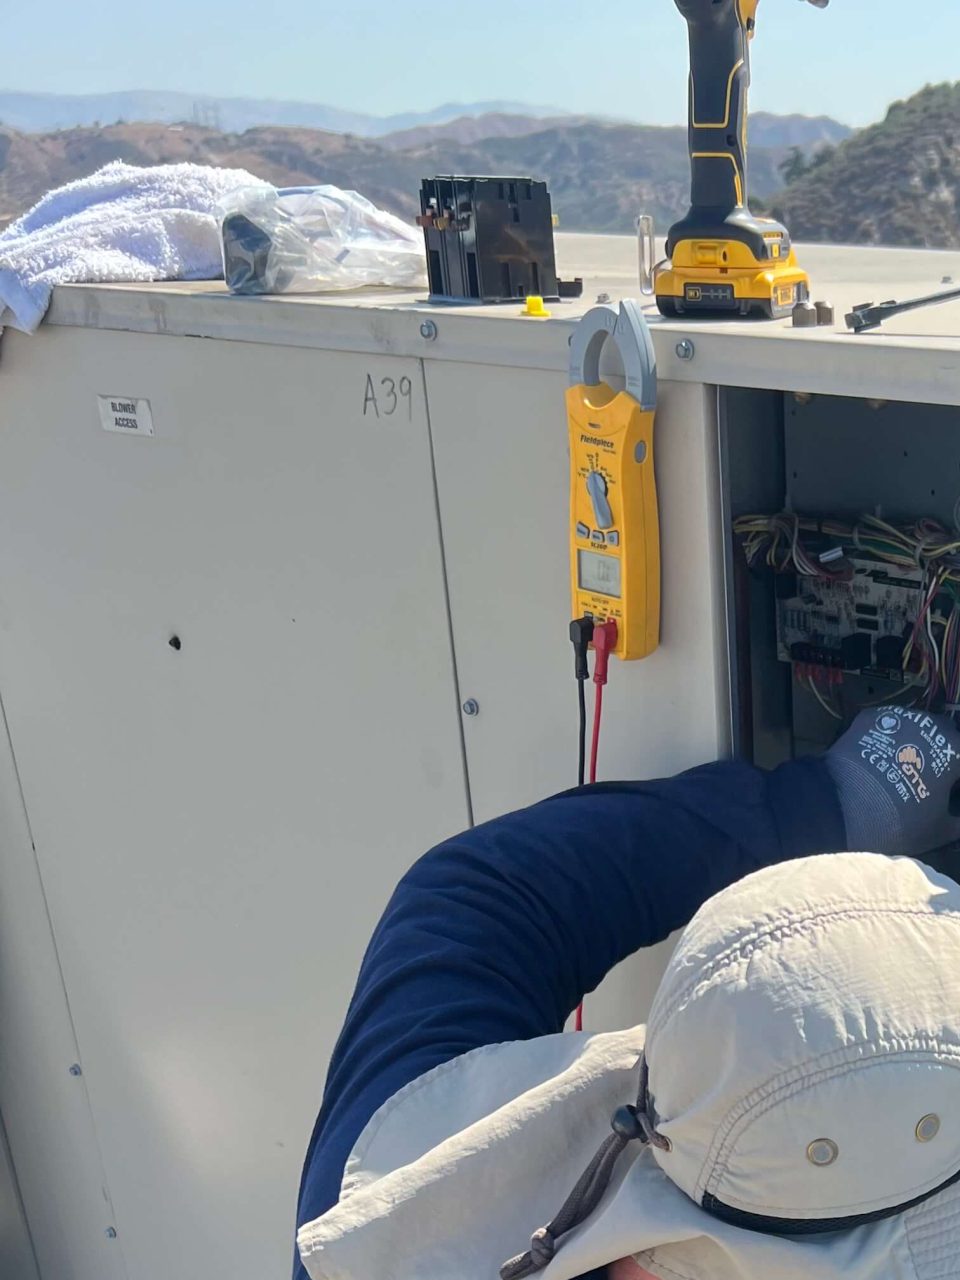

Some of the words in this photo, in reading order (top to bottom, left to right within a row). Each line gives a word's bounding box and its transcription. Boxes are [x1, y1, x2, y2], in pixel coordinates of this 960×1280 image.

[363, 373, 412, 422] A39
[110, 401, 137, 415] BLOWER
[114, 416, 138, 429] ACCESS
[580, 434, 615, 449] Fieldpiece
